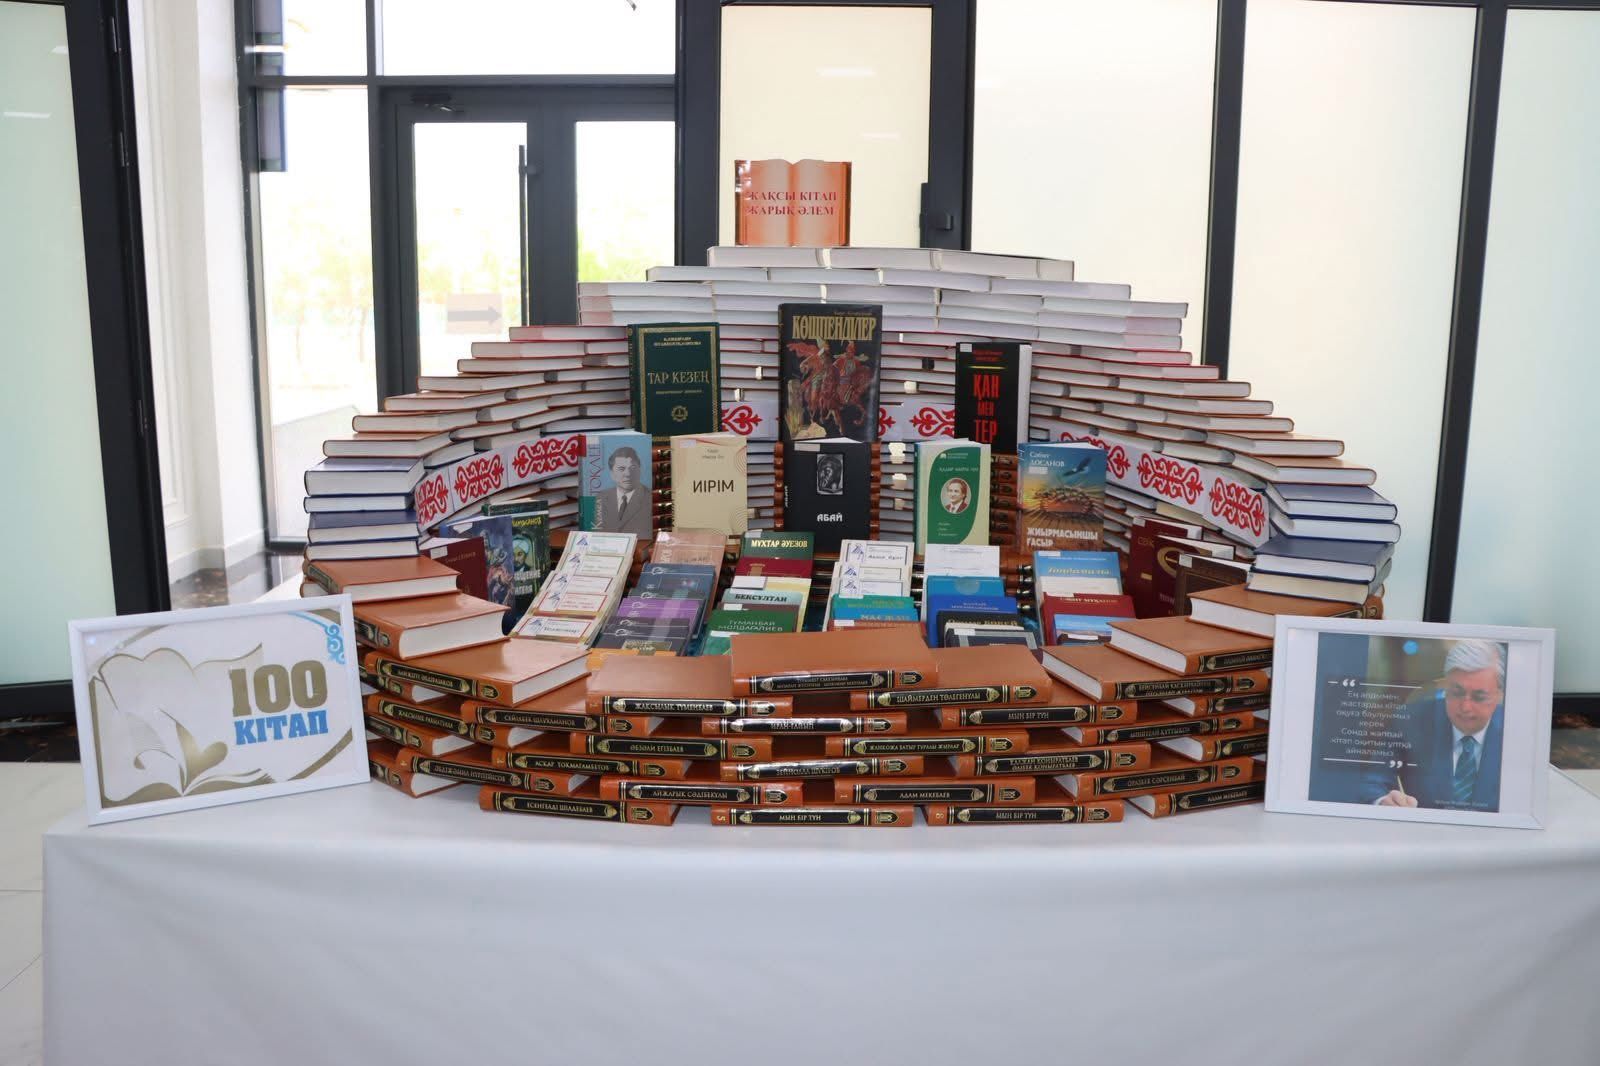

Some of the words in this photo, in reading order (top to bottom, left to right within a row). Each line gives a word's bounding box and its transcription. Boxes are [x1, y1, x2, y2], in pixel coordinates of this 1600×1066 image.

[800, 191, 836, 201] КІТАП
[798, 206, 834, 215] ӘЛЕМ
[648, 372, 669, 385] ТАР
[672, 370, 710, 384] КЕЗЕҢ
[974, 419, 998, 443] ТЕР
[693, 479, 734, 493] ИІРІМ
[817, 512, 843, 522] АБАЙ
[781, 539, 808, 548] ӘУЕЗОВ
[228, 660, 328, 717] 100
[896, 693, 938, 703] ШАЙМЕРДЕН
[234, 709, 329, 746] КІТАП
[1341, 727, 1368, 736] Сонда
[1370, 730, 1403, 738] жаппай
[1331, 737, 1352, 745] кітап
[1346, 748, 1394, 757] айналамыз
[1013, 811, 1024, 819] БІР
